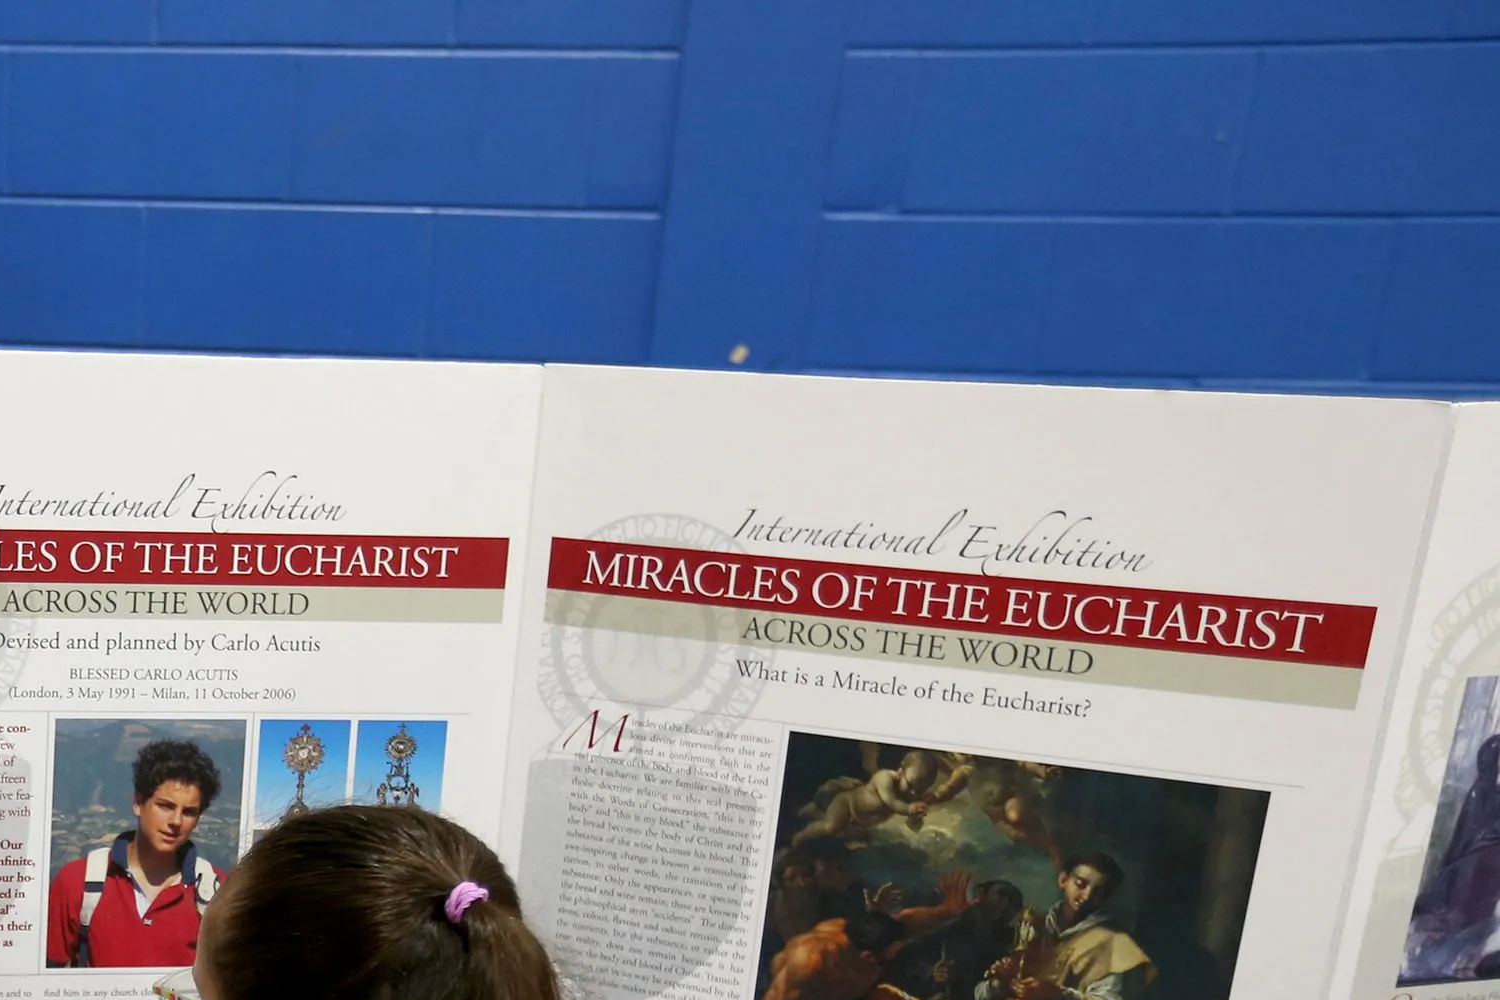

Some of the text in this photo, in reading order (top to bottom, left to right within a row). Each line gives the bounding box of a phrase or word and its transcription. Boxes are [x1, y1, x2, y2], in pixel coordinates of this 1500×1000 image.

[191, 471, 348, 534] Exhibition
[733, 508, 1152, 577] International Exhibition
[70, 540, 124, 572] OF
[134, 541, 217, 573] THE
[231, 544, 458, 577] EUCHARIST
[2, 589, 308, 615] ACROSS THE WORLD
[583, 550, 1324, 654] MIRACLES OF THE EUCHARIST
[66, 631, 98, 649] and
[106, 632, 176, 655] planned
[184, 632, 204, 656] by
[211, 633, 259, 651] Carlo
[266, 634, 320, 651] Acutis
[743, 618, 1093, 674] ACROSS THE WORLD
[69, 668, 238, 681] BLESSED CARLO ACUTIS
[8, 687, 62, 700] (London,
[66, 688, 74, 699] 3
[78, 688, 104, 702] May
[109, 688, 136, 699] 1991
[152, 688, 190, 701] Milan,
[195, 689, 206, 700] 11
[212, 688, 258, 700] October
[263, 688, 296, 702] 2006)
[736, 659, 1091, 717] What is a Miracle of the Eucharist?
[3, 755, 16, 767] of
[16, 789, 32, 800] fea-
[7, 805, 31, 817] with
[17, 872, 34, 882] ho-
[14, 888, 24, 898] in
[7, 920, 32, 931] their
